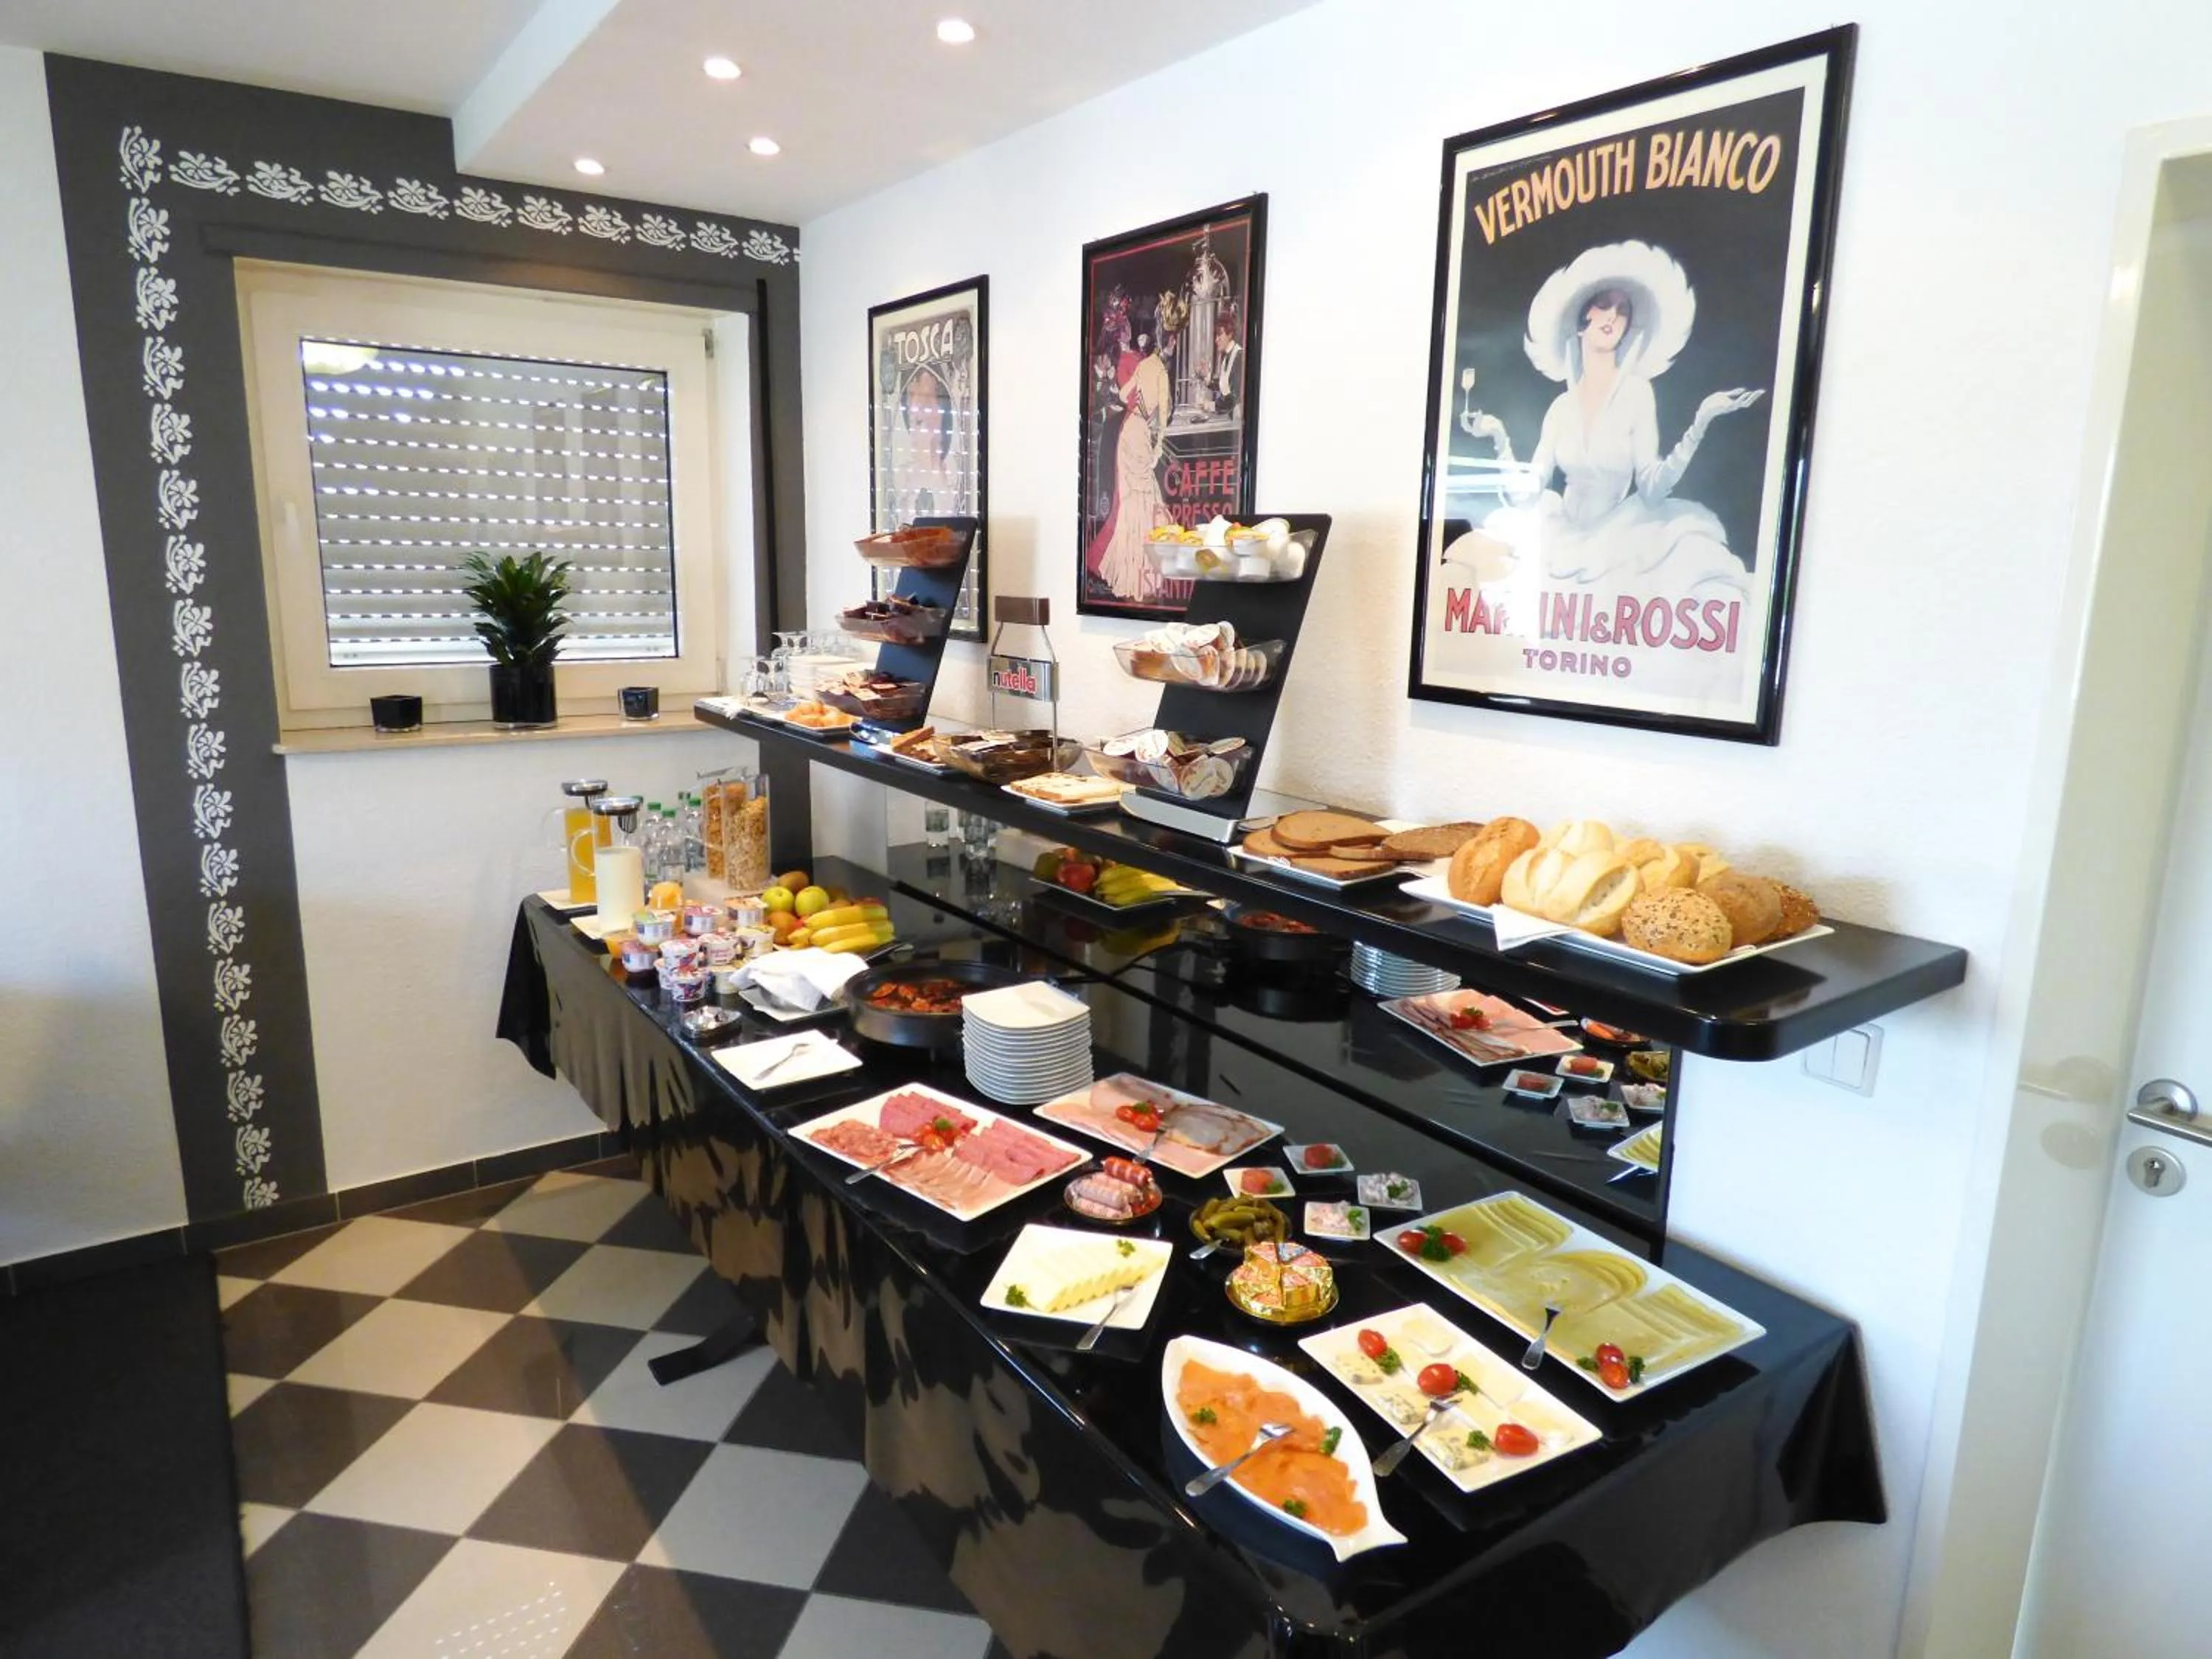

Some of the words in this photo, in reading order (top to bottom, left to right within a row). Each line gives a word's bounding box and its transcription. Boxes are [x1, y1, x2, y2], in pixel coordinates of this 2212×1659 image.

[1474, 137, 1636, 245] VERMOUTH
[1645, 129, 1781, 195] BIANCO
[894, 319, 953, 365] TOSCA
[1444, 588, 1741, 653] MAINI&ROSSI
[992, 666, 1037, 693] nutella
[1523, 648, 1632, 678] TORINO
